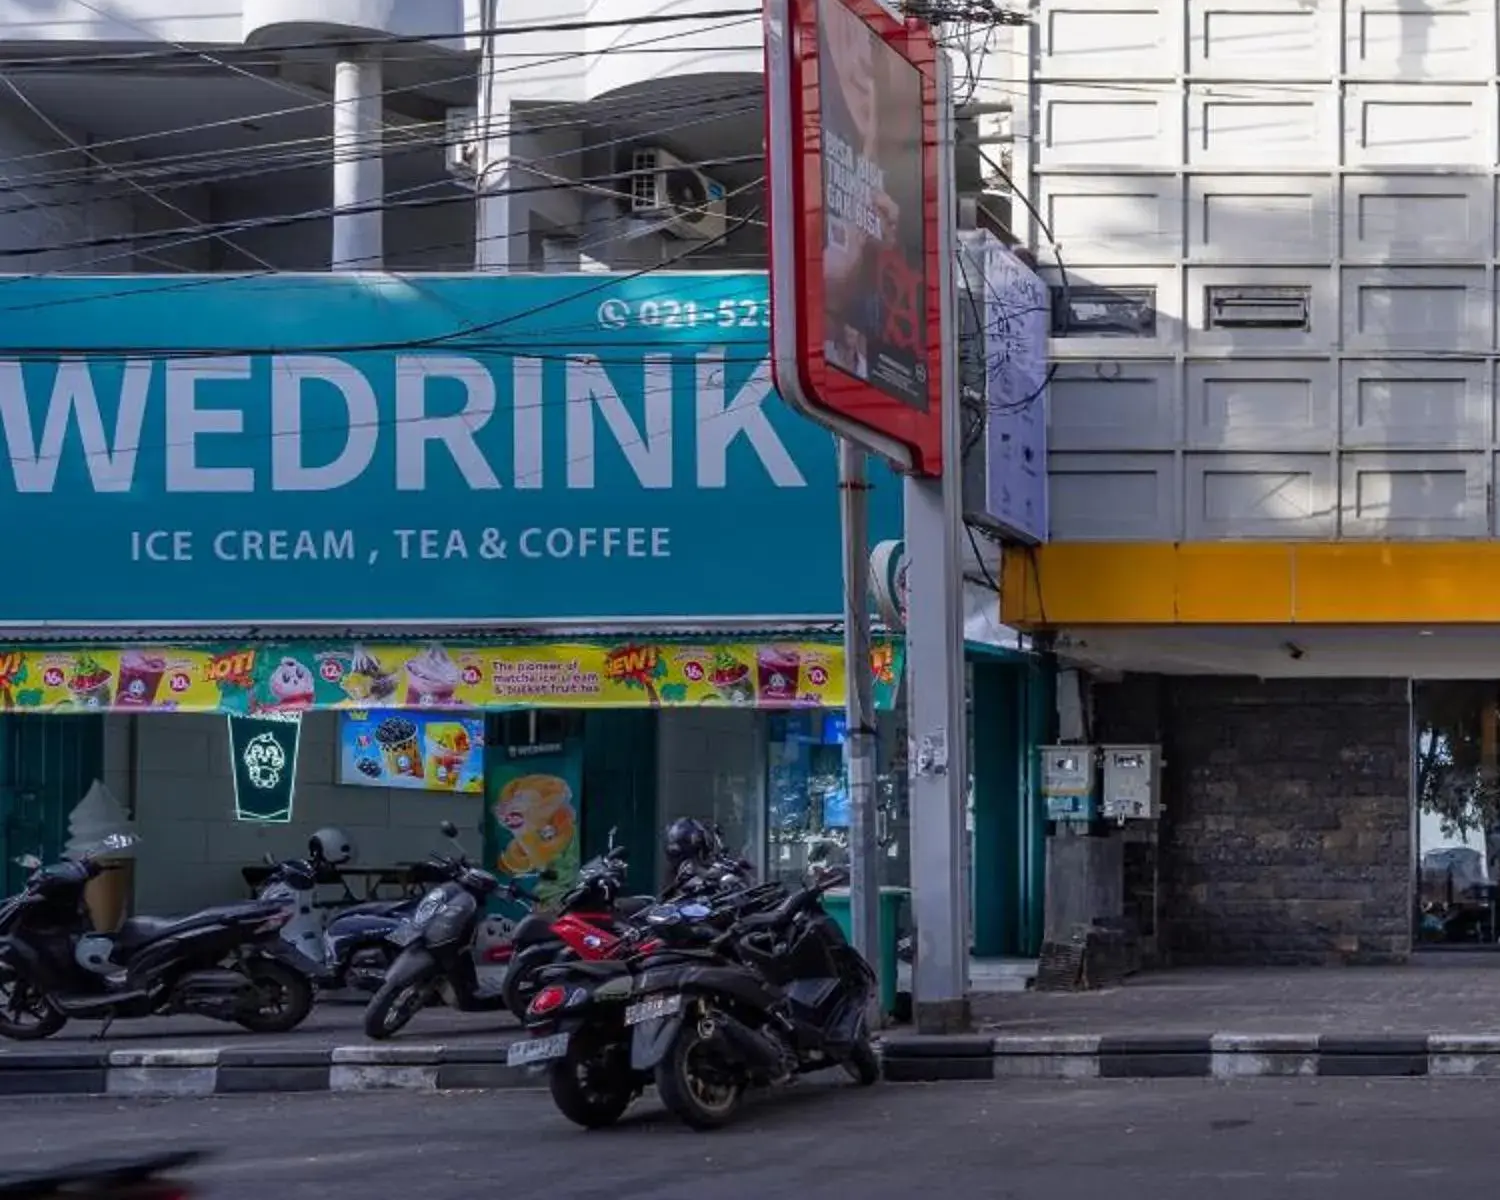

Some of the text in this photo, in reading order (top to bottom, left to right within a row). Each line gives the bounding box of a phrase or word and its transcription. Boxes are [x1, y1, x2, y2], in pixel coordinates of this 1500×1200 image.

[0, 352, 808, 493] WEDRINK
[130, 530, 193, 561] ICE
[213, 528, 355, 561] CREAM
[518, 526, 671, 559] COFFEE
